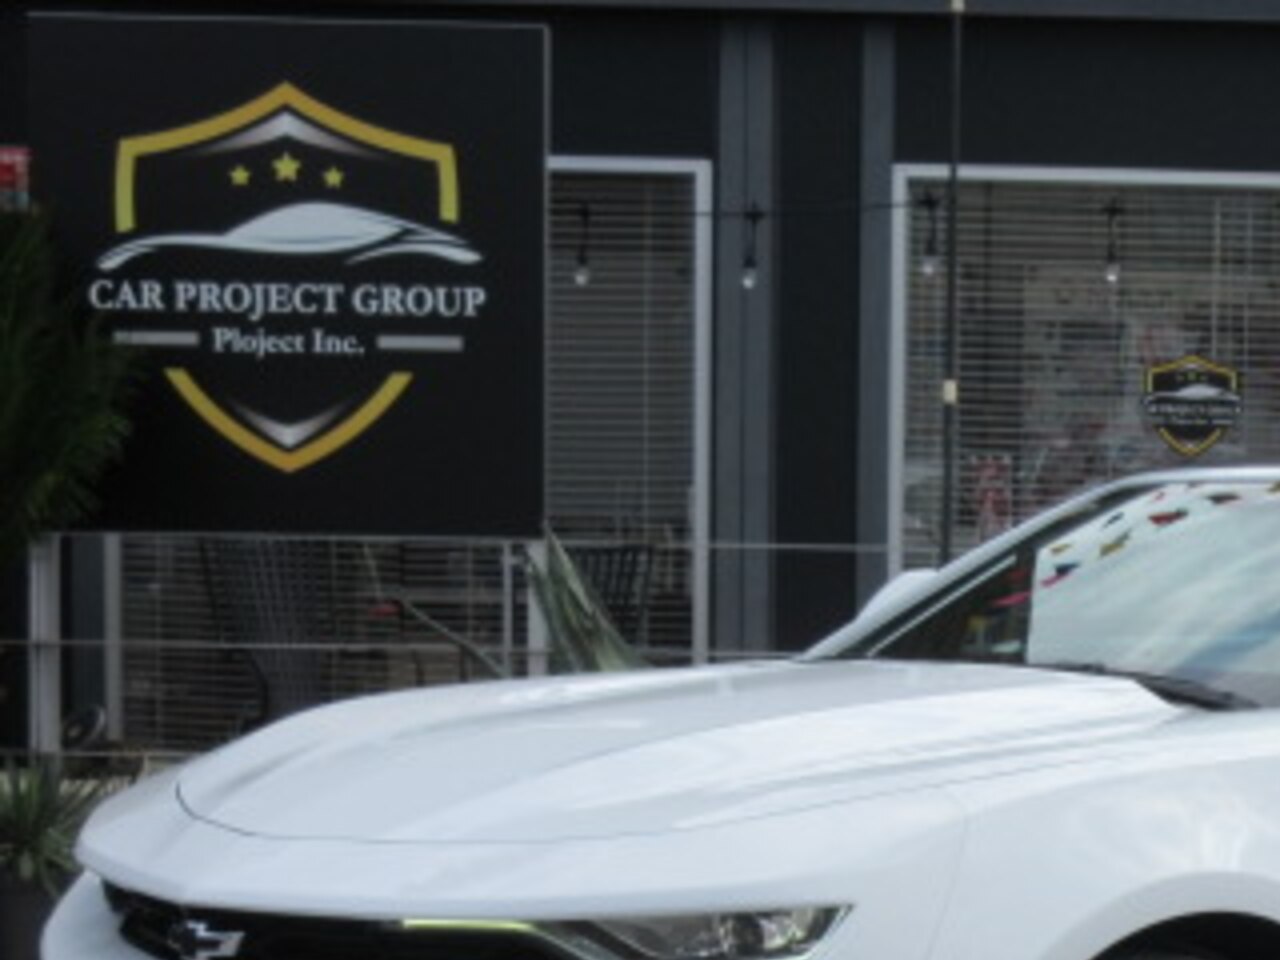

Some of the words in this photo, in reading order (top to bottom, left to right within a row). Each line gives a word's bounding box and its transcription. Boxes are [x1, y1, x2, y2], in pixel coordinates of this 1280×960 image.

[88, 279, 164, 310] CAR
[174, 280, 344, 321] PROJECT
[351, 283, 487, 316] GROUP
[212, 327, 305, 358] Ploject
[311, 329, 366, 354] Inc.
